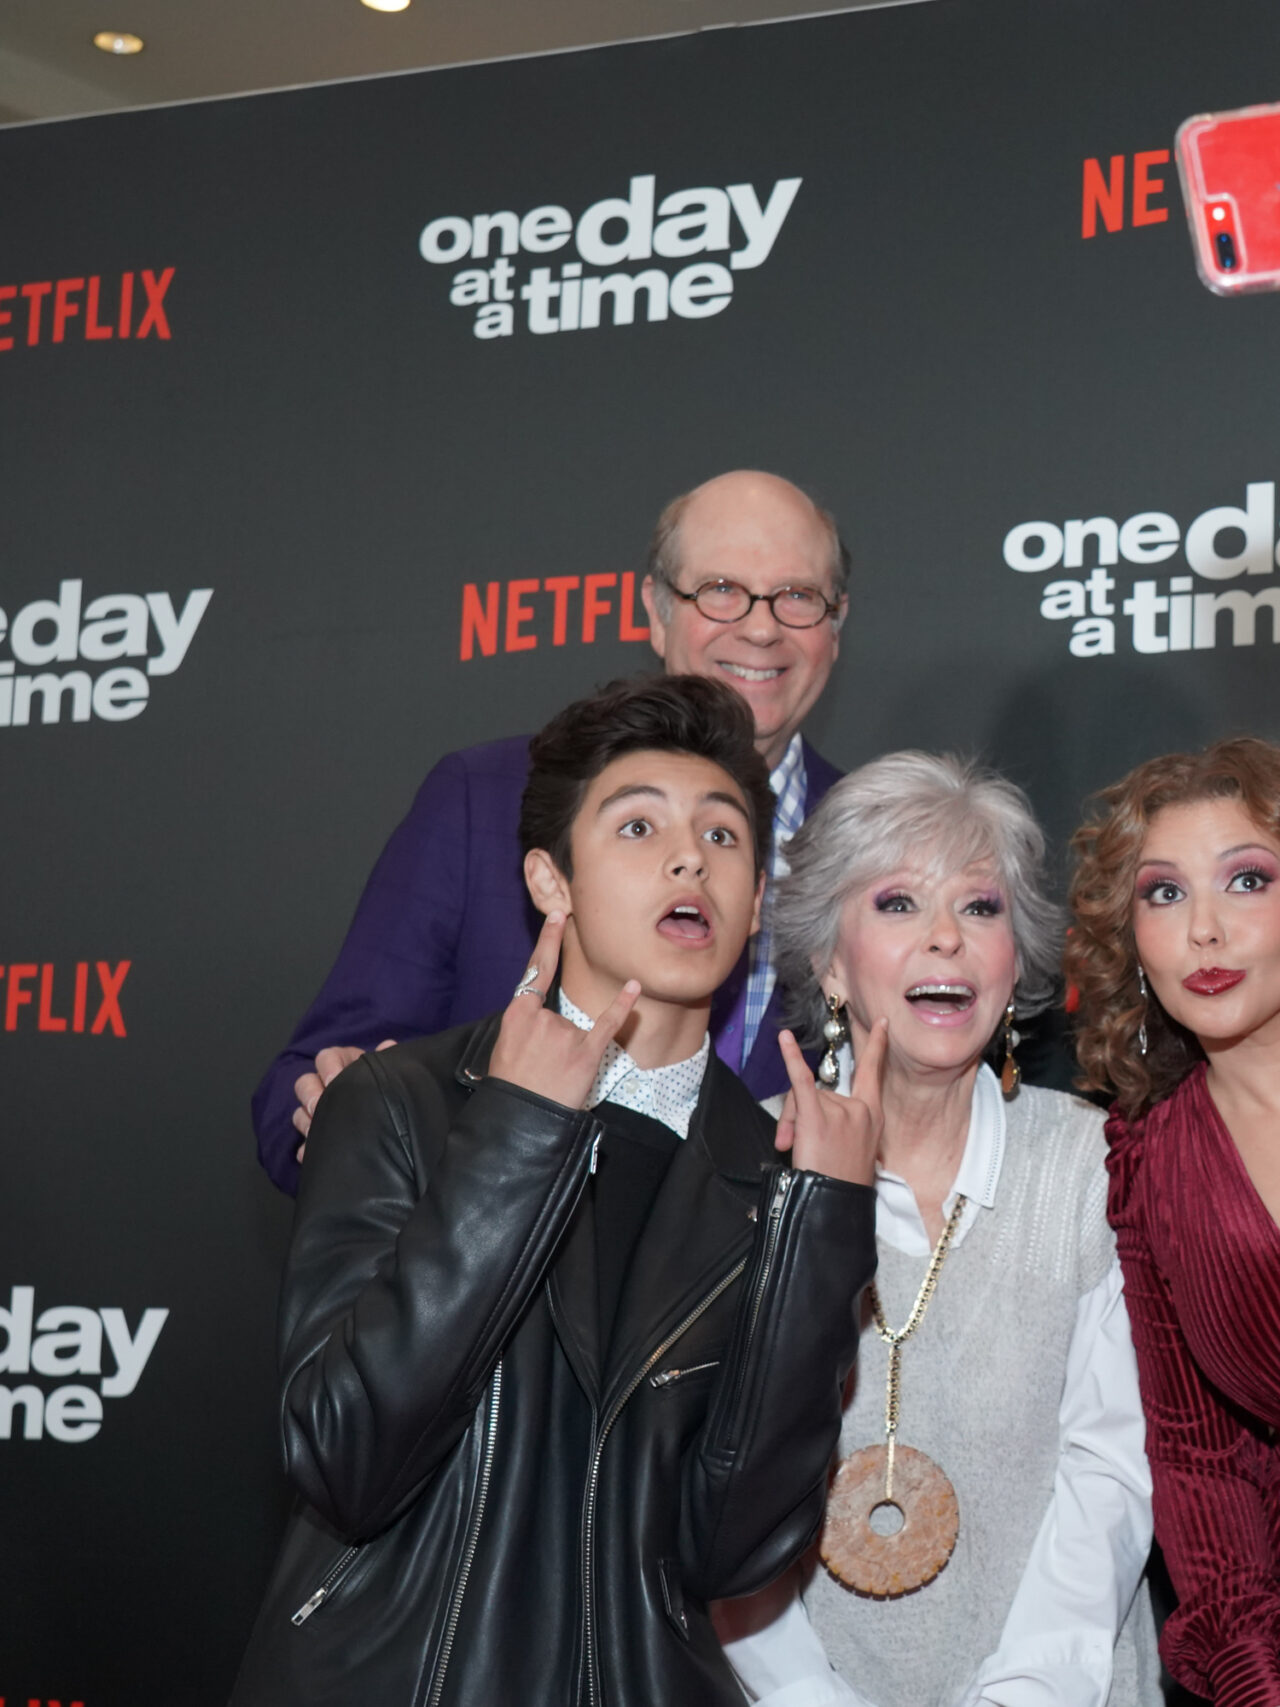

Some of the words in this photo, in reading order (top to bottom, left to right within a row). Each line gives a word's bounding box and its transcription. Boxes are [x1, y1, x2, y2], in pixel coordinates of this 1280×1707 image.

[420, 205, 573, 264] one
[575, 174, 803, 270] day
[450, 257, 516, 306] at
[474, 302, 514, 339] a
[521, 262, 734, 335] time
[1003, 511, 1181, 573] one
[10, 578, 214, 676] day
[1040, 567, 1116, 620] at
[1069, 617, 1116, 658] a
[0, 960, 132, 1038] FLIX
